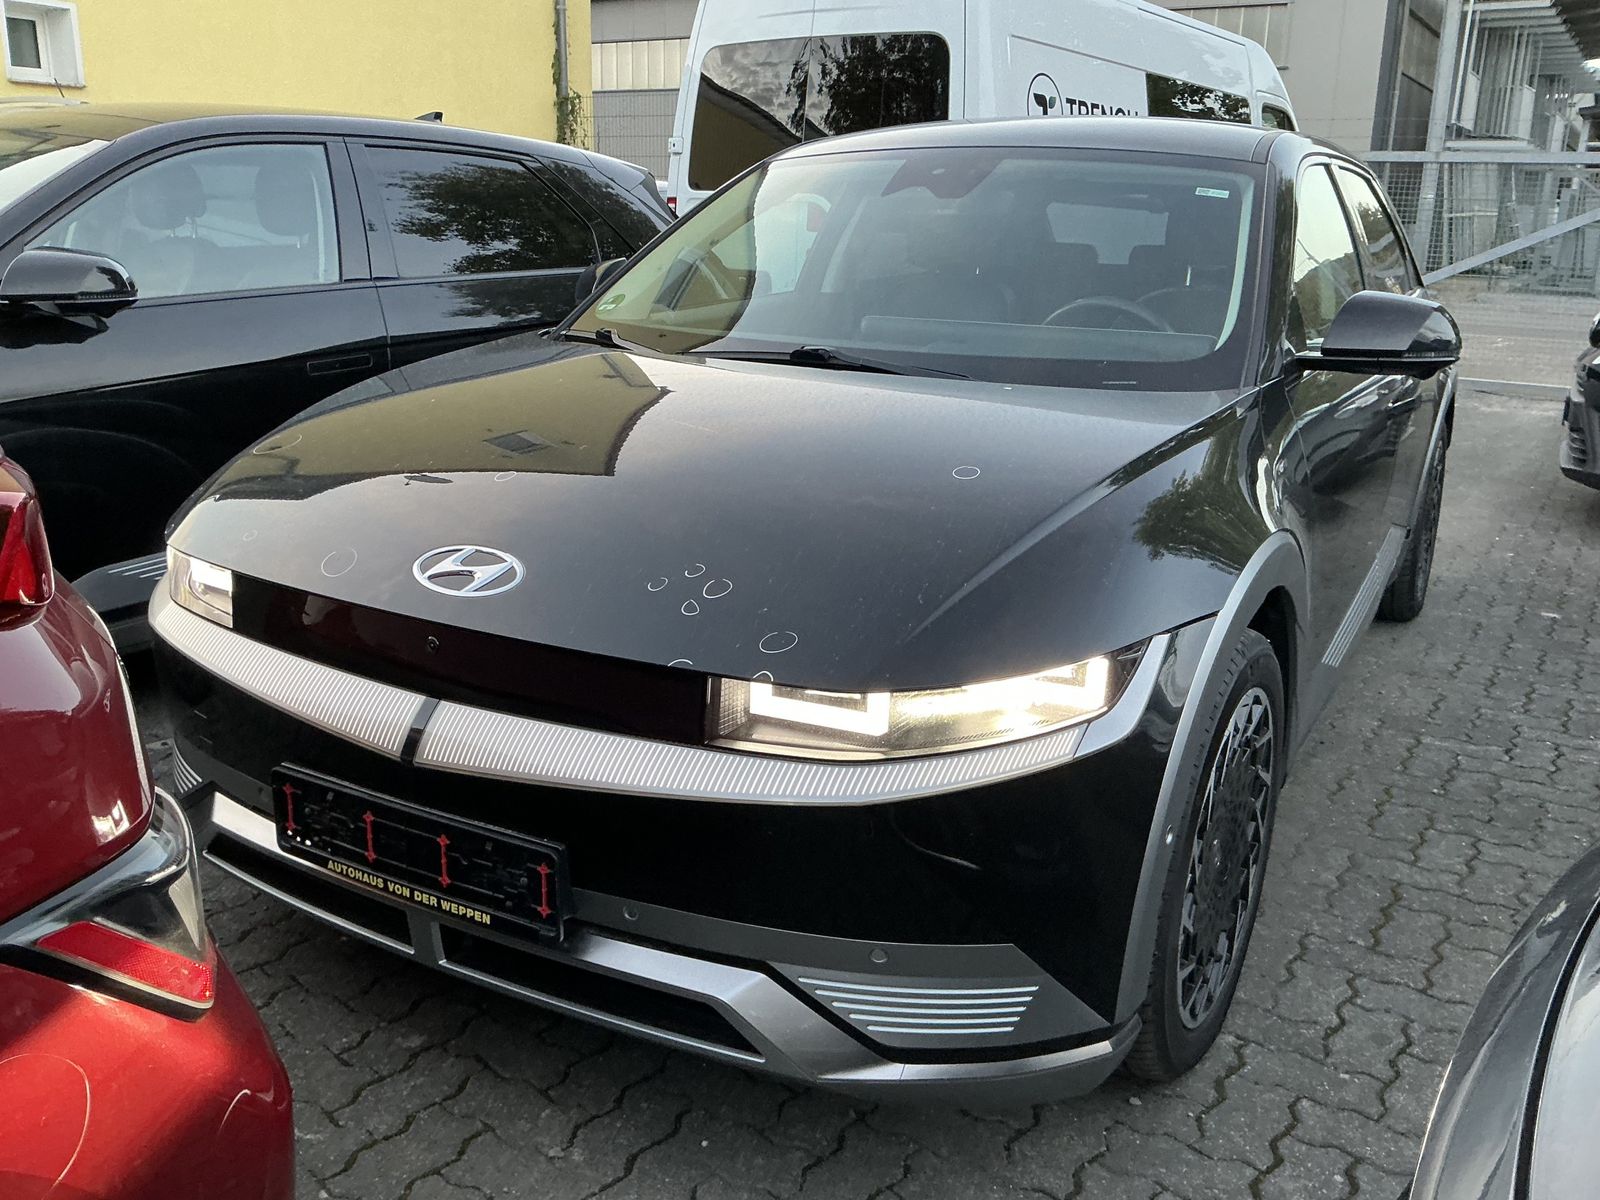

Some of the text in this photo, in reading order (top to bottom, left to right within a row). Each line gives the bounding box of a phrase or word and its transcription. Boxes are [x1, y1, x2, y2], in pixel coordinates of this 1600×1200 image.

[327, 860, 491, 925] AUTOHAUS VON DER WEPPEN
